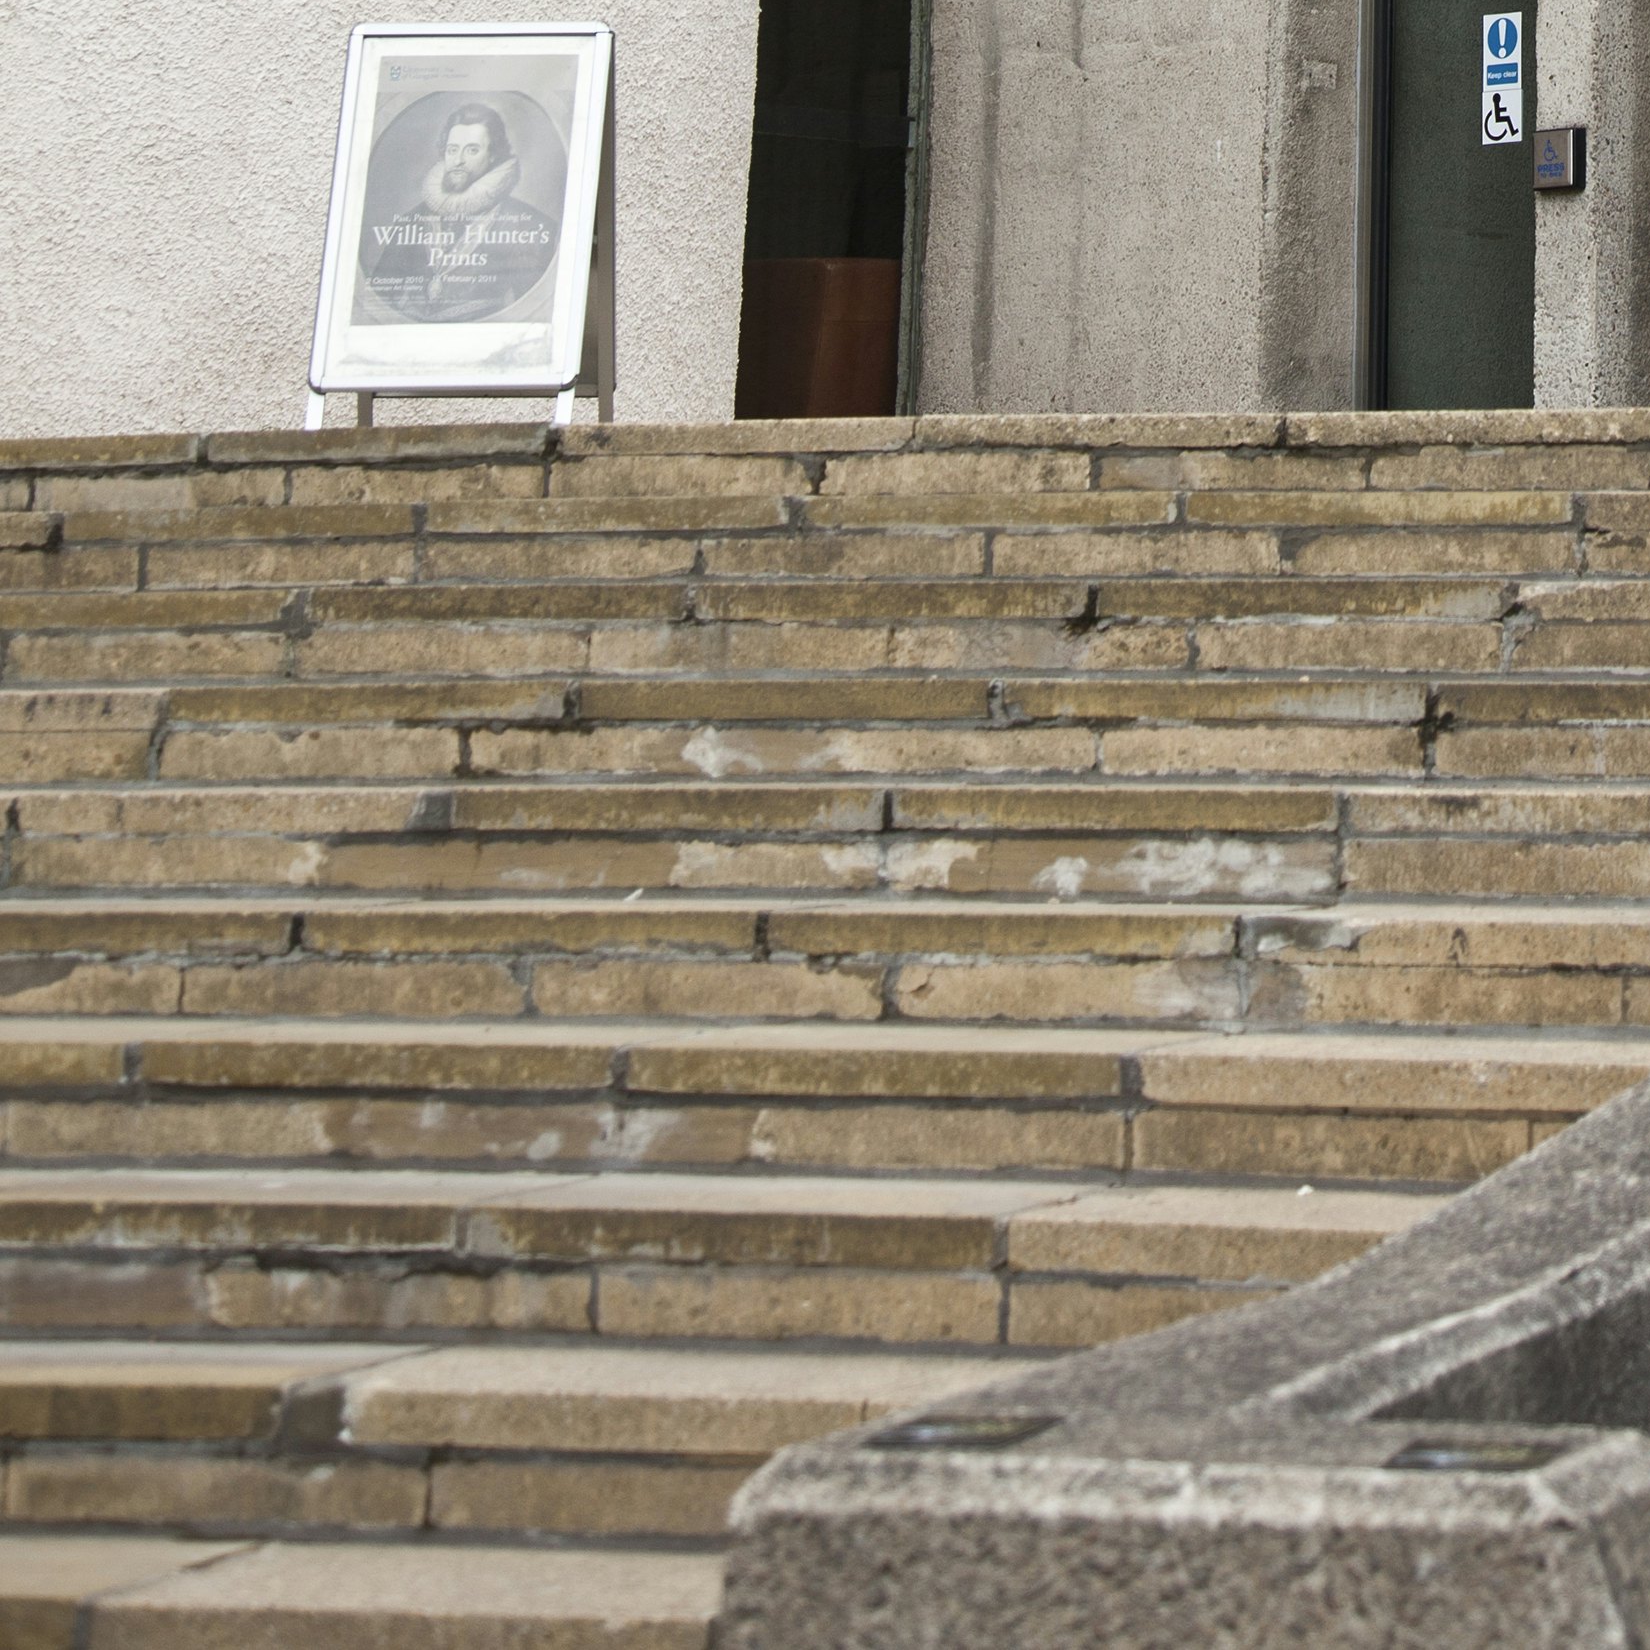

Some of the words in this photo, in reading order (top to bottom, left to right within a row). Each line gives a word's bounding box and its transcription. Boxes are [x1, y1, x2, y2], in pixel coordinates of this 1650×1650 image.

[1488, 71, 1502, 80] Keep
[1503, 70, 1517, 78] clear
[1537, 162, 1565, 172] PRESS
[519, 212, 532, 222] for
[372, 225, 455, 246] William
[463, 223, 550, 245] Hunter's
[427, 247, 488, 267] Prints
[373, 275, 404, 285] October
[405, 275, 424, 284] 2010
[442, 274, 477, 285] February
[478, 274, 497, 283] 2011
